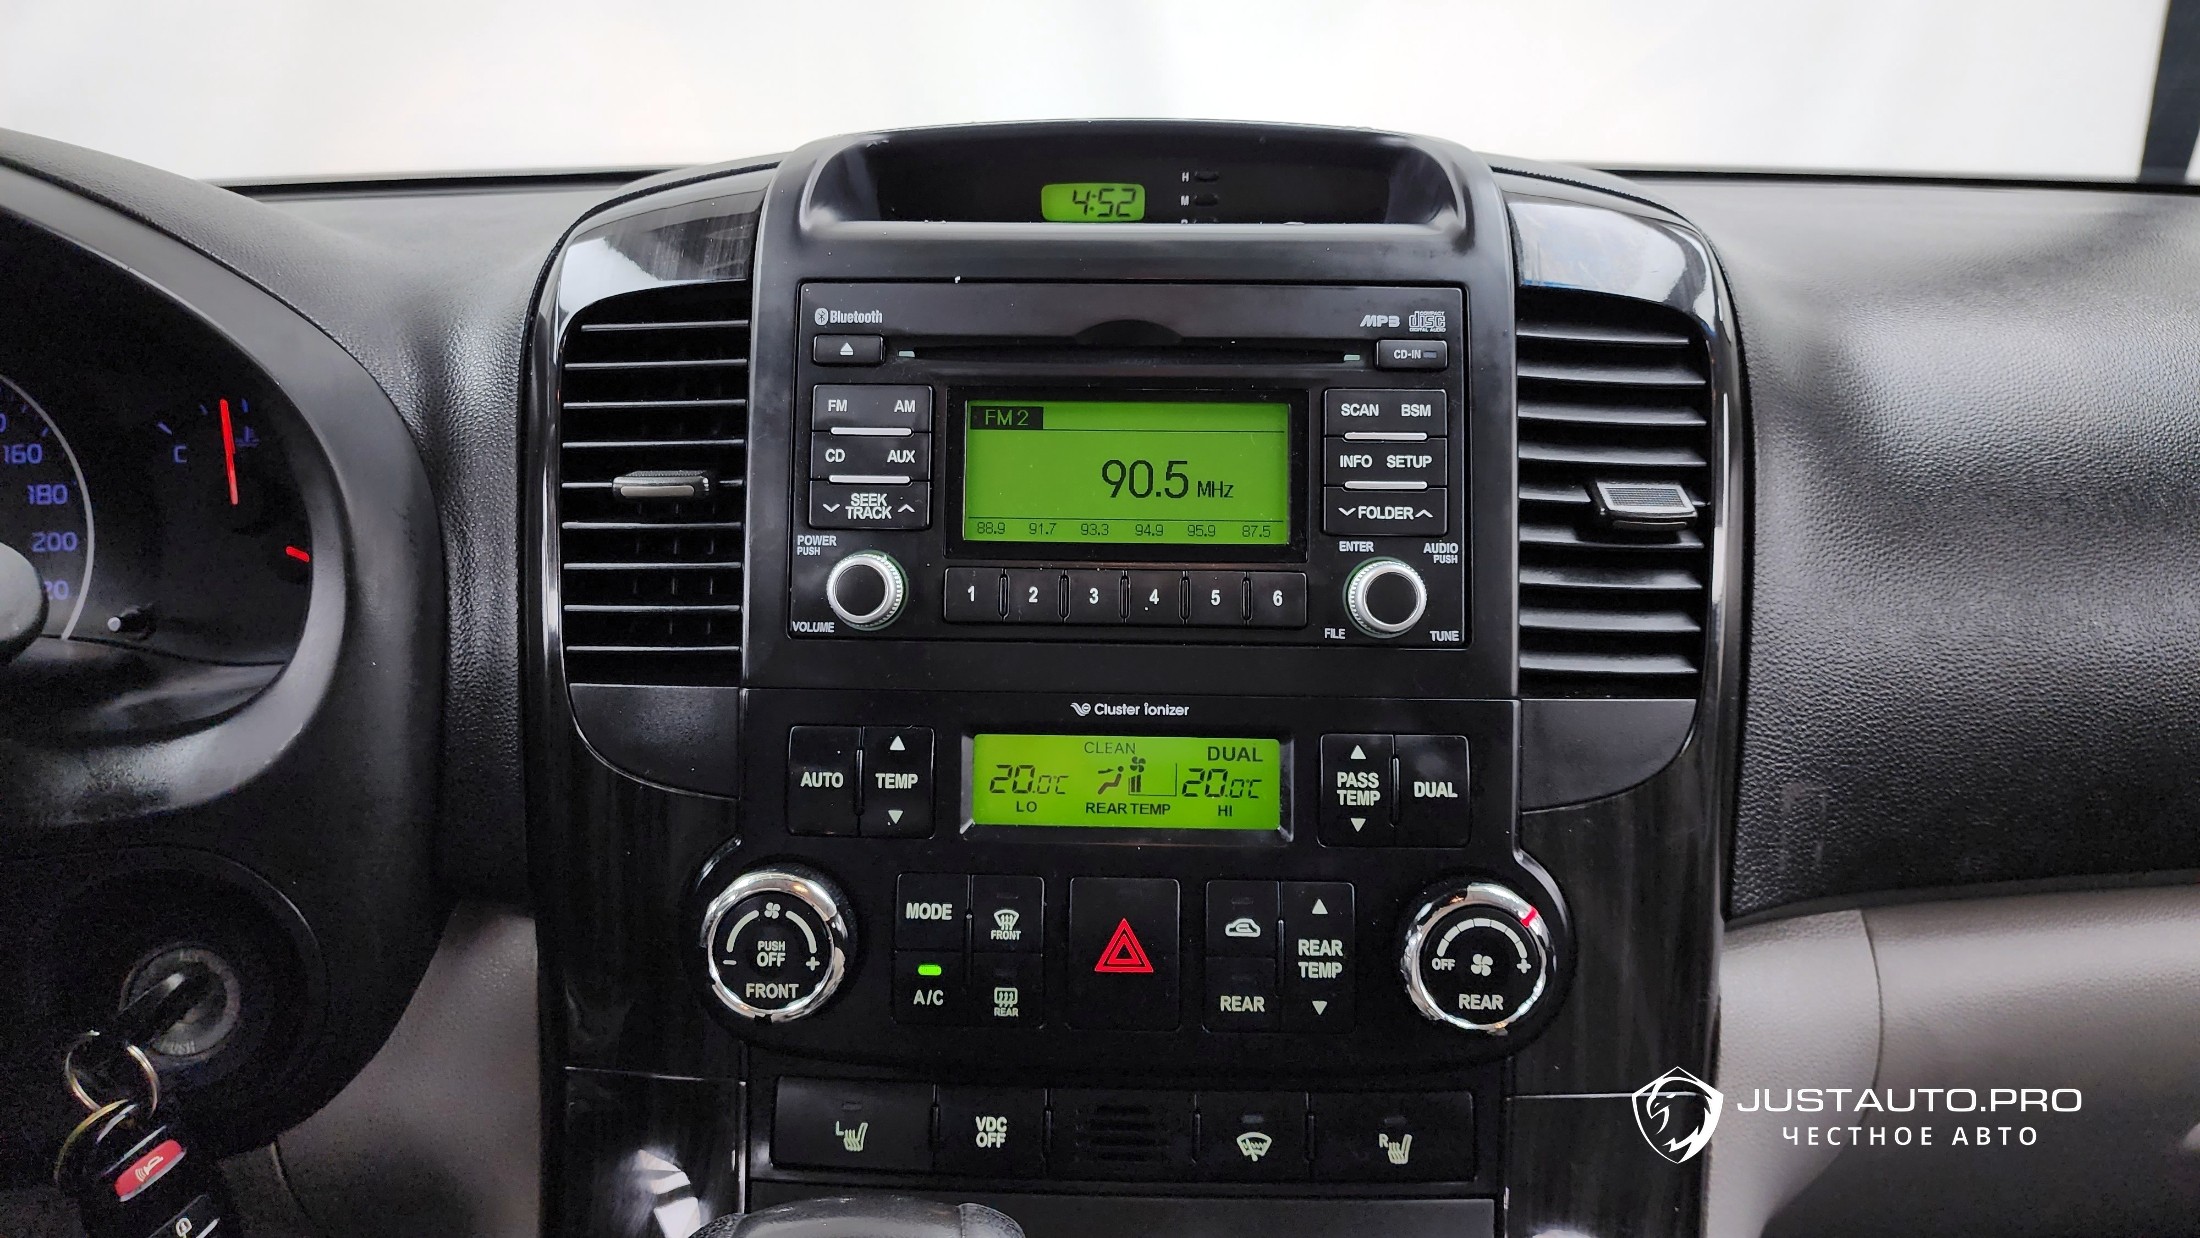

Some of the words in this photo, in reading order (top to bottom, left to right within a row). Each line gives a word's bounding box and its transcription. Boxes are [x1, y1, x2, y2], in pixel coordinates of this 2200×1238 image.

[1182, 172, 1189, 182] H
[1072, 188, 1136, 217] 4:52
[1181, 195, 1189, 206] M
[830, 309, 882, 323] Bluetooth
[1394, 350, 1421, 359] CD-IN
[828, 400, 847, 412] FM
[894, 400, 916, 413] AM
[1341, 404, 1379, 417] SCAN
[1401, 404, 1431, 417] BSM
[3, 443, 43, 464] 160
[825, 449, 845, 462] CD
[887, 450, 916, 463] AUX
[1339, 455, 1372, 468] INFO
[1386, 455, 1432, 468] SETUP
[1101, 459, 1188, 499] 90.5
[1197, 484, 1234, 498] MHz
[27, 484, 68, 504] 180
[850, 493, 887, 506] SEEK
[846, 507, 892, 519] TRACK
[1358, 507, 1414, 520] FOLDER
[977, 523, 1006, 534] 88.9
[1029, 523, 1057, 535] 91.7
[1080, 523, 1109, 535] 93.3
[1135, 524, 1164, 537] 94.9
[1187, 525, 1216, 537] 95.9
[1242, 526, 1271, 538] 87.5
[31, 532, 78, 551] 200
[797, 535, 837, 546] POWER
[1339, 542, 1374, 552] ENTER
[797, 546, 820, 555] PUSH
[1423, 543, 1458, 554] AUDIO
[1434, 555, 1458, 564] PUSH
[967, 586, 975, 601] 1
[1029, 587, 1038, 602] 2
[1089, 588, 1098, 603] 3
[1150, 589, 1159, 604] 4
[1211, 590, 1220, 605] 5
[1273, 590, 1283, 606] 6
[792, 622, 834, 632] VOLUME
[1324, 628, 1345, 639] FILE
[1430, 631, 1459, 641] TUNE
[1094, 703, 1140, 716] Cluster
[1084, 742, 1136, 754] CLEAN
[1208, 746, 1263, 762] DUAL
[800, 772, 843, 788] AUTO
[876, 772, 918, 788] TEMP
[1337, 772, 1379, 788] PASS
[1414, 781, 1457, 798] DUAL
[1337, 790, 1380, 806] TEMP
[1016, 800, 1037, 813] LO
[1086, 802, 1127, 814] REAR
[1131, 803, 1170, 815] TEMP
[1218, 804, 1233, 817] HI
[906, 902, 952, 920] MODE
[990, 930, 1021, 940] FRONT
[758, 940, 785, 952] PUSH
[1298, 939, 1343, 957] REAR
[756, 951, 786, 967] OFF
[1432, 958, 1455, 971] OFF
[1298, 962, 1342, 979] TEMP
[745, 983, 799, 999] FRONT
[913, 989, 944, 1006] A/C
[1220, 996, 1265, 1012] REAR
[1459, 994, 1503, 1010] REAR
[994, 1007, 1018, 1017] REAR
[836, 1121, 844, 1136] L
[975, 1116, 1007, 1132] VDC
[976, 1132, 1006, 1148] OFF
[1379, 1133, 1388, 1148] R
